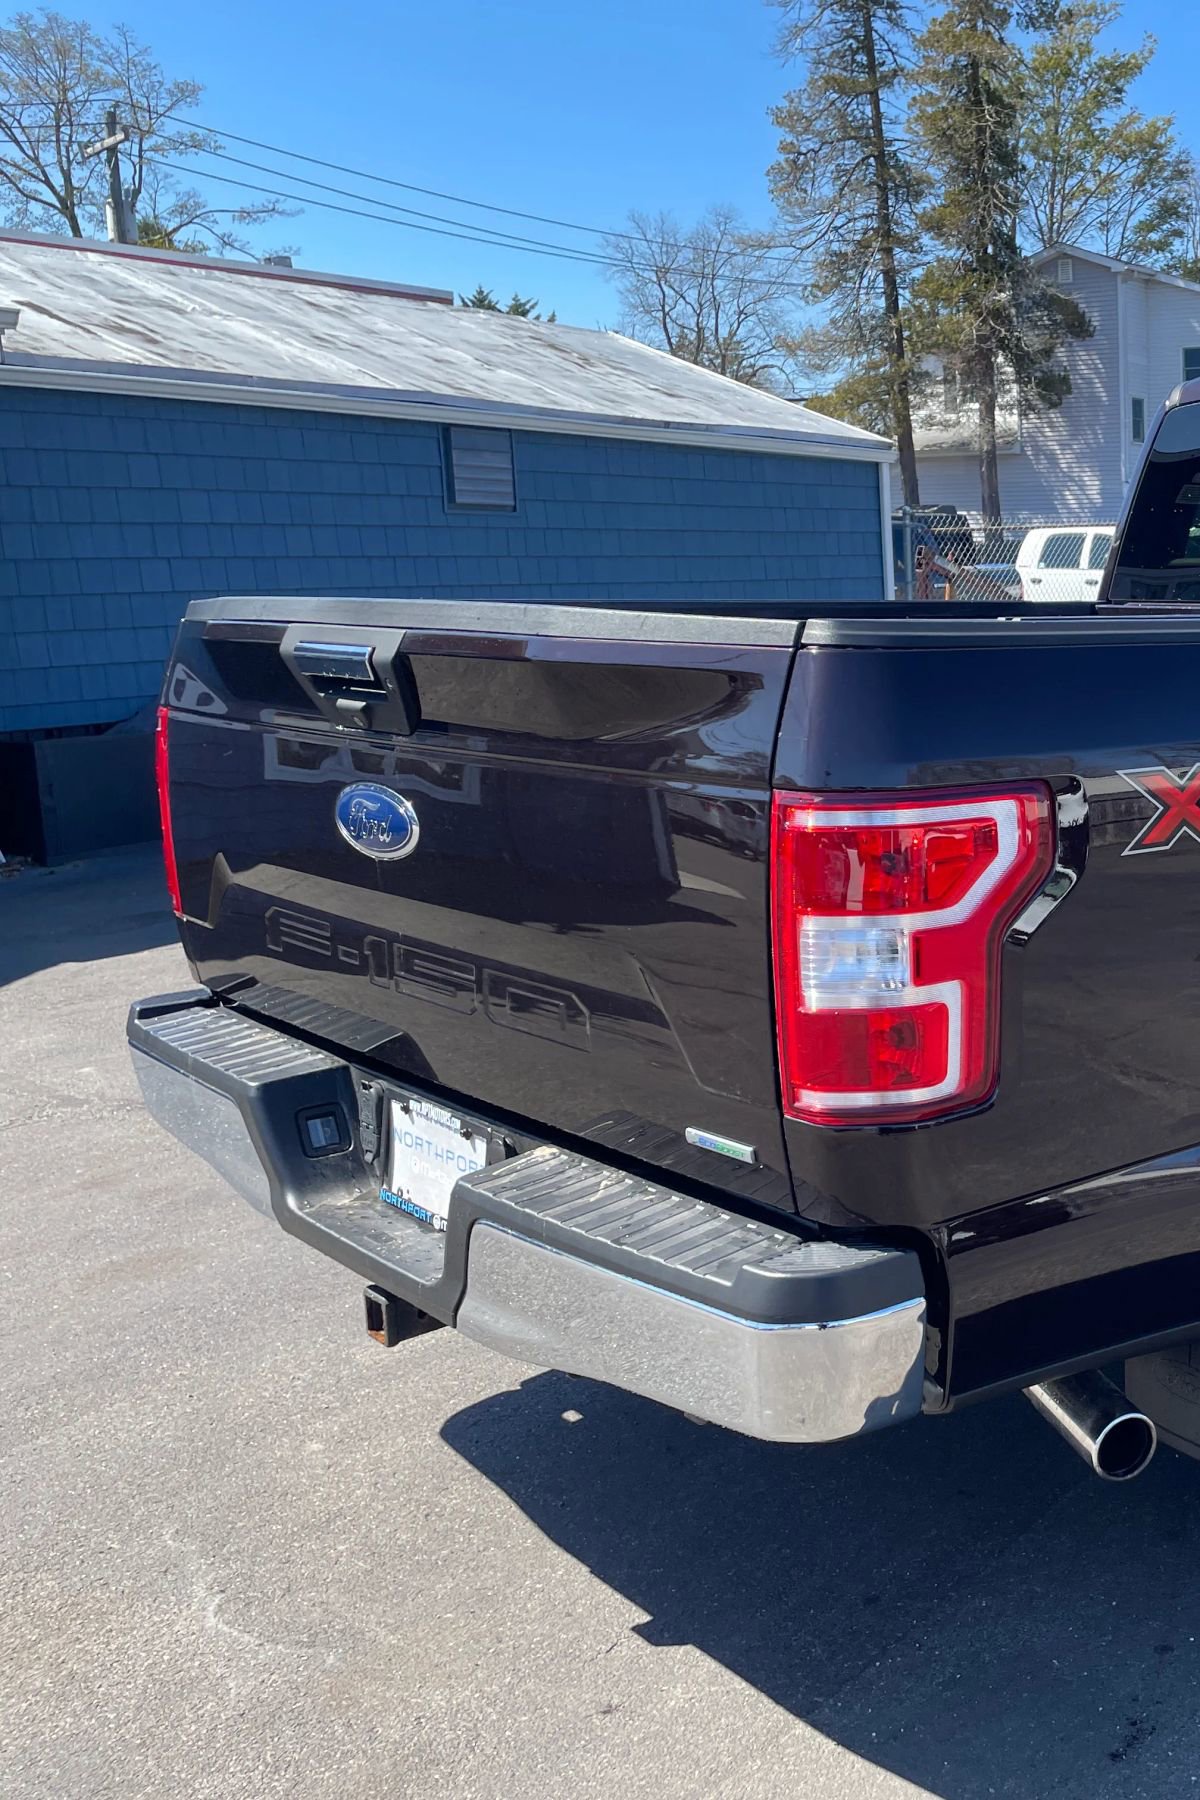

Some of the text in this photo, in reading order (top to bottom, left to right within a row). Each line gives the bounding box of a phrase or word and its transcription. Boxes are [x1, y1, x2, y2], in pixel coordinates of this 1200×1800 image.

[348, 798, 393, 843] Ford
[264, 905, 593, 1054] F-150
[392, 1127, 487, 1173] NORTHPOR
[379, 1187, 433, 1224] NORTHPORT
